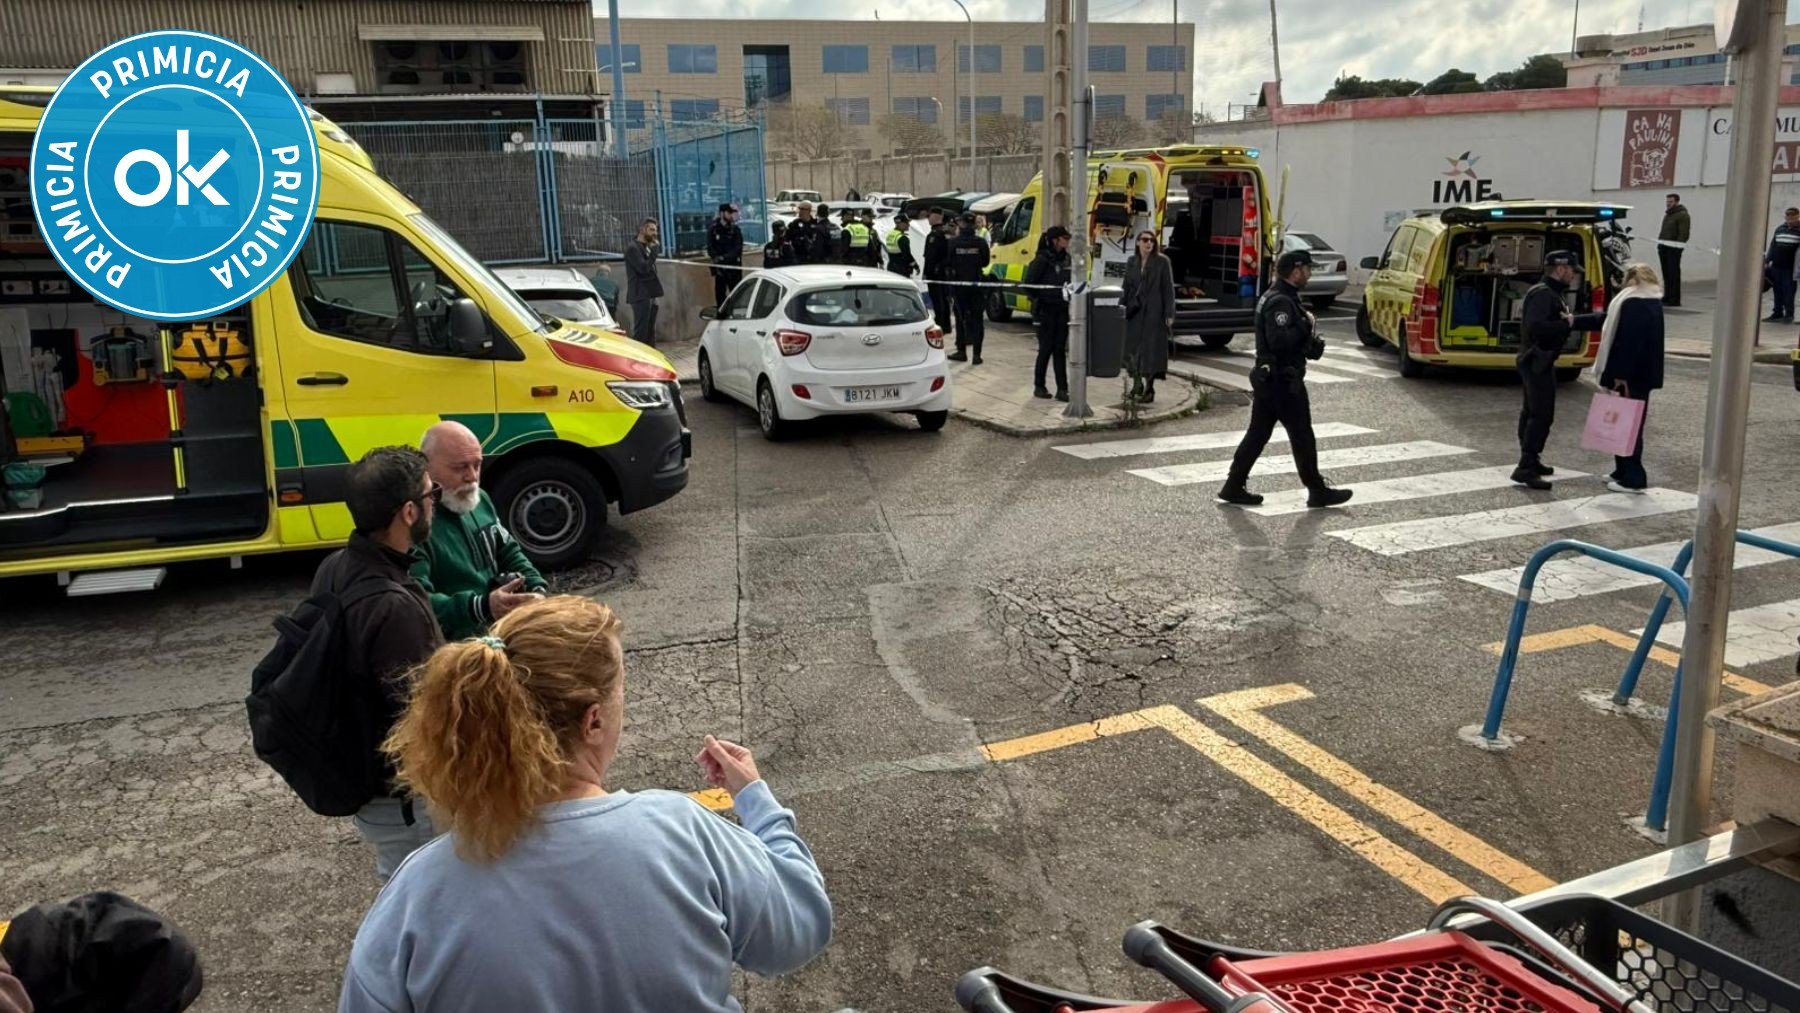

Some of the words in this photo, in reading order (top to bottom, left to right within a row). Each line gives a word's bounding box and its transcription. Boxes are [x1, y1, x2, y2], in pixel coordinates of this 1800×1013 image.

[1628, 128, 1674, 150] PAULINA
[1433, 179, 1492, 203] IME
[568, 389, 595, 402] A10
